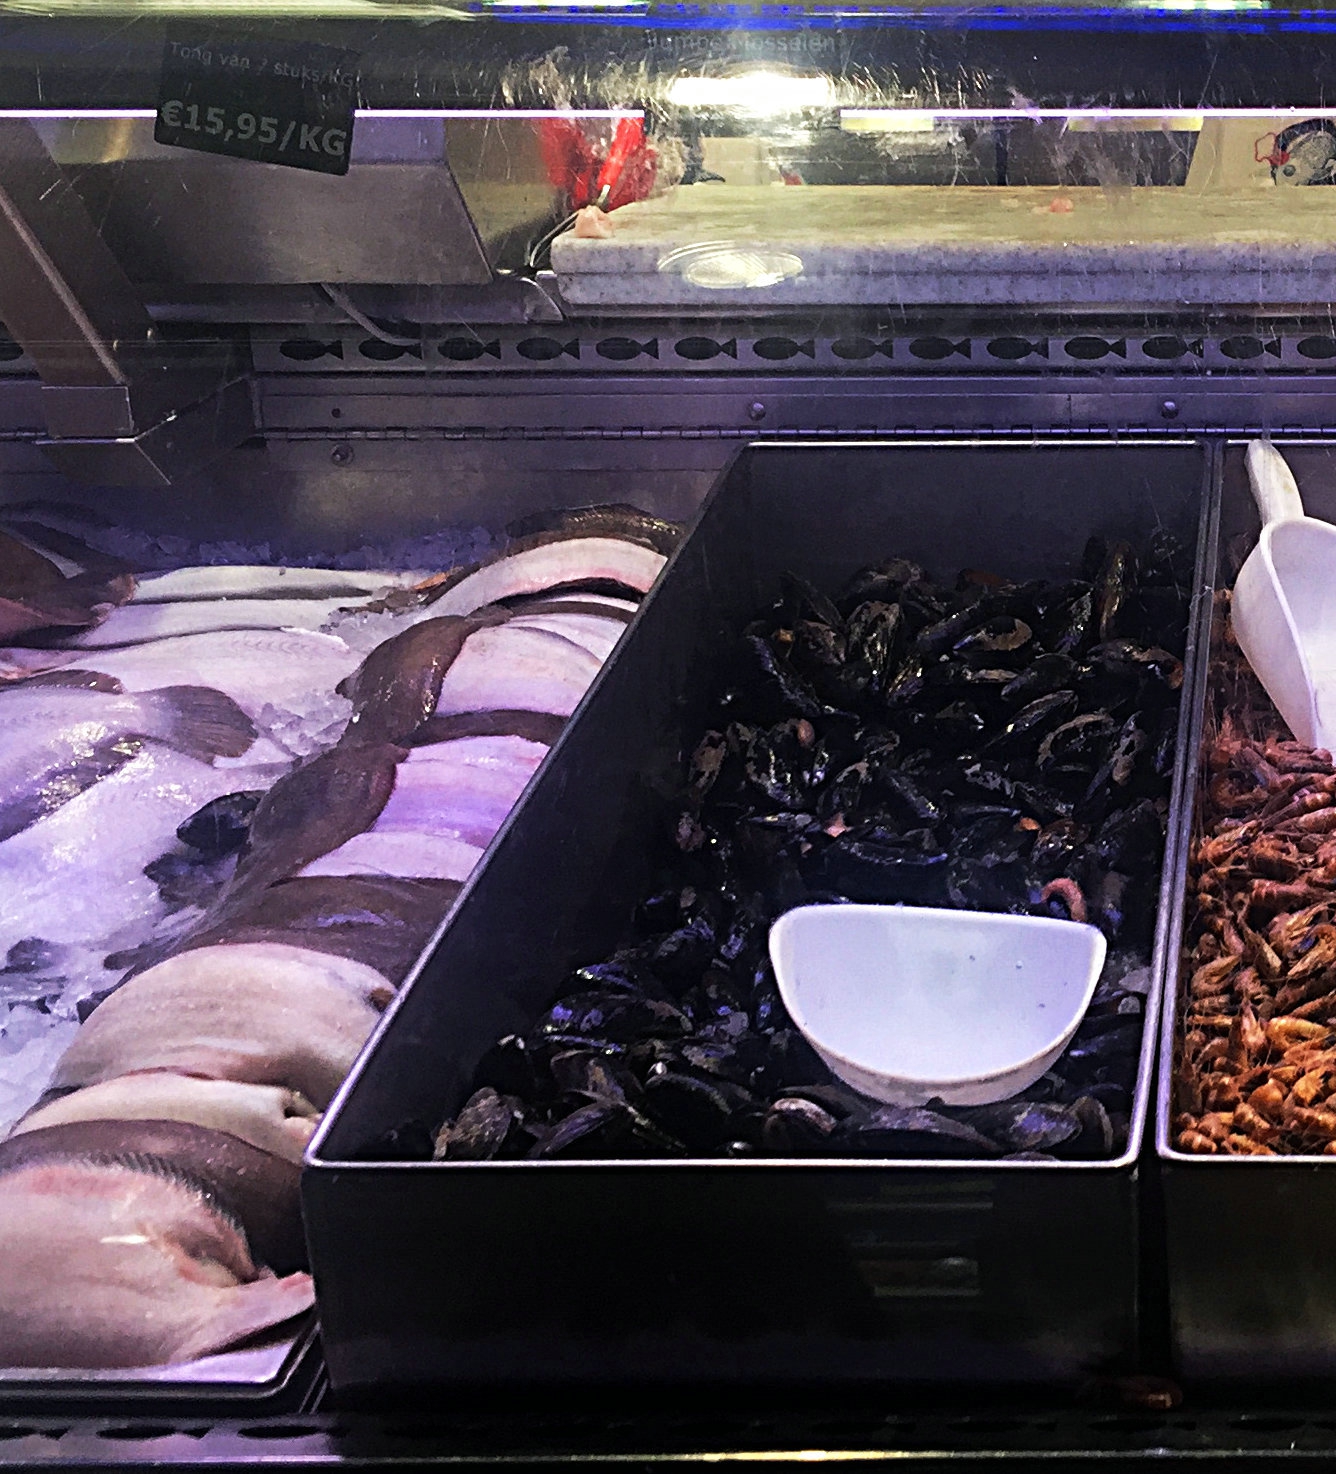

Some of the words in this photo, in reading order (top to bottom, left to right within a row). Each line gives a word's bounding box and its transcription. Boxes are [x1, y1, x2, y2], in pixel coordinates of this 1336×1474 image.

[170, 41, 212, 66] Tong
[218, 52, 250, 70] van
[161, 99, 347, 156] €15,95/KG
